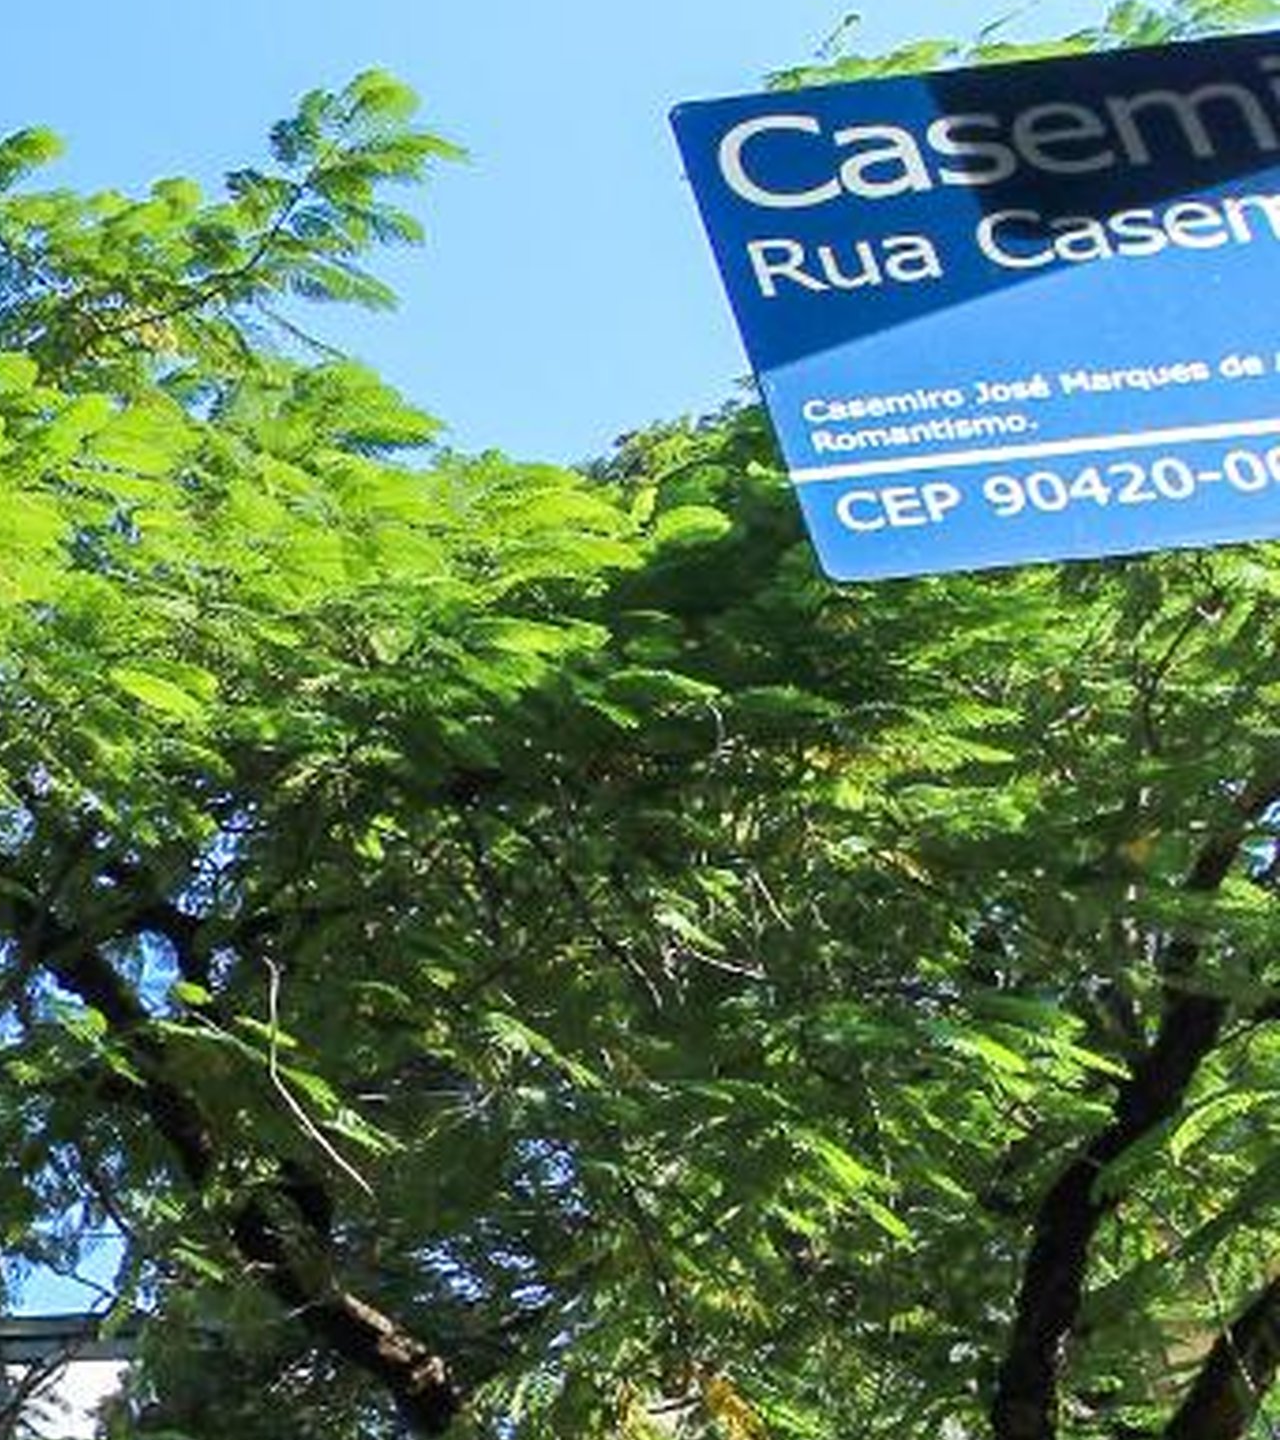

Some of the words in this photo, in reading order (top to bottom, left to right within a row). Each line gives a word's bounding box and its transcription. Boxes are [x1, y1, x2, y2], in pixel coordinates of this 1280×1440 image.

[747, 234, 943, 298] Rua
[803, 389, 964, 422] Casemiro
[975, 373, 1048, 403] José
[1058, 361, 1211, 395] Marques
[811, 414, 1038, 452] Romantismo.
[837, 482, 960, 531] CEP
